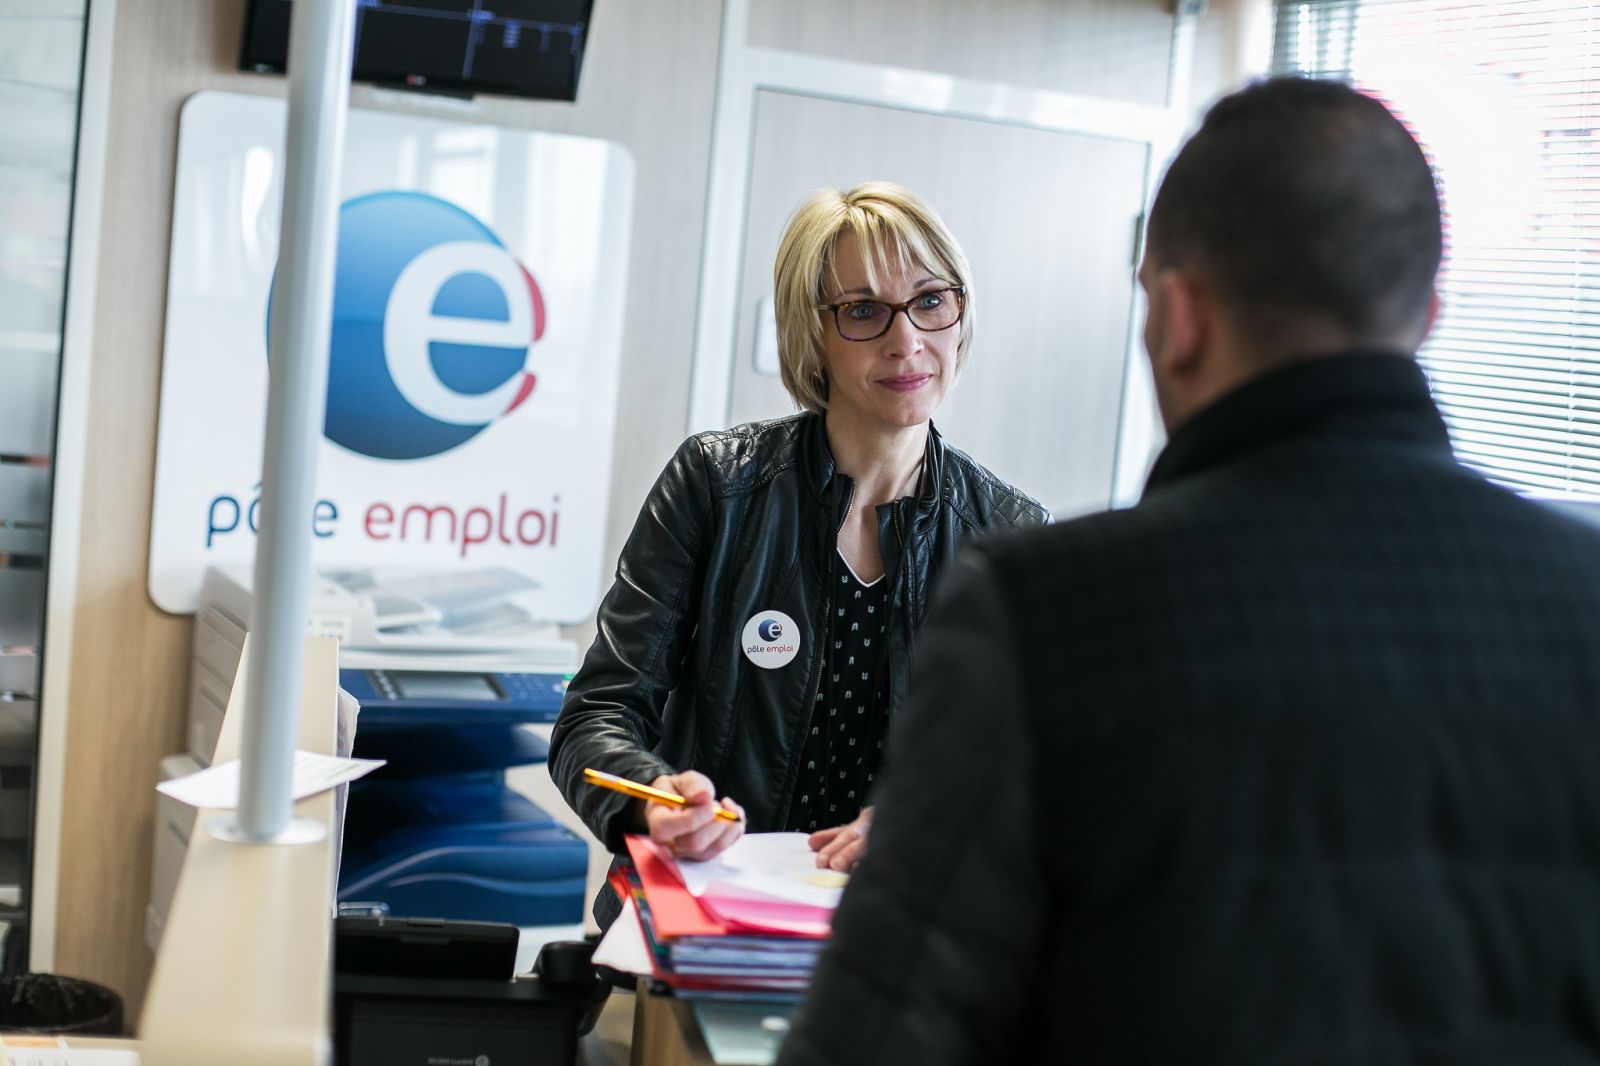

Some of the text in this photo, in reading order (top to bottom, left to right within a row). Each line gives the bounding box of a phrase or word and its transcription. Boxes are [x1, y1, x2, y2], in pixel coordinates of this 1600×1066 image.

[382, 239, 542, 427] e
[205, 481, 561, 558] pe emploi
[747, 644, 794, 654] pôle emploi
[768, 622, 783, 639] e
